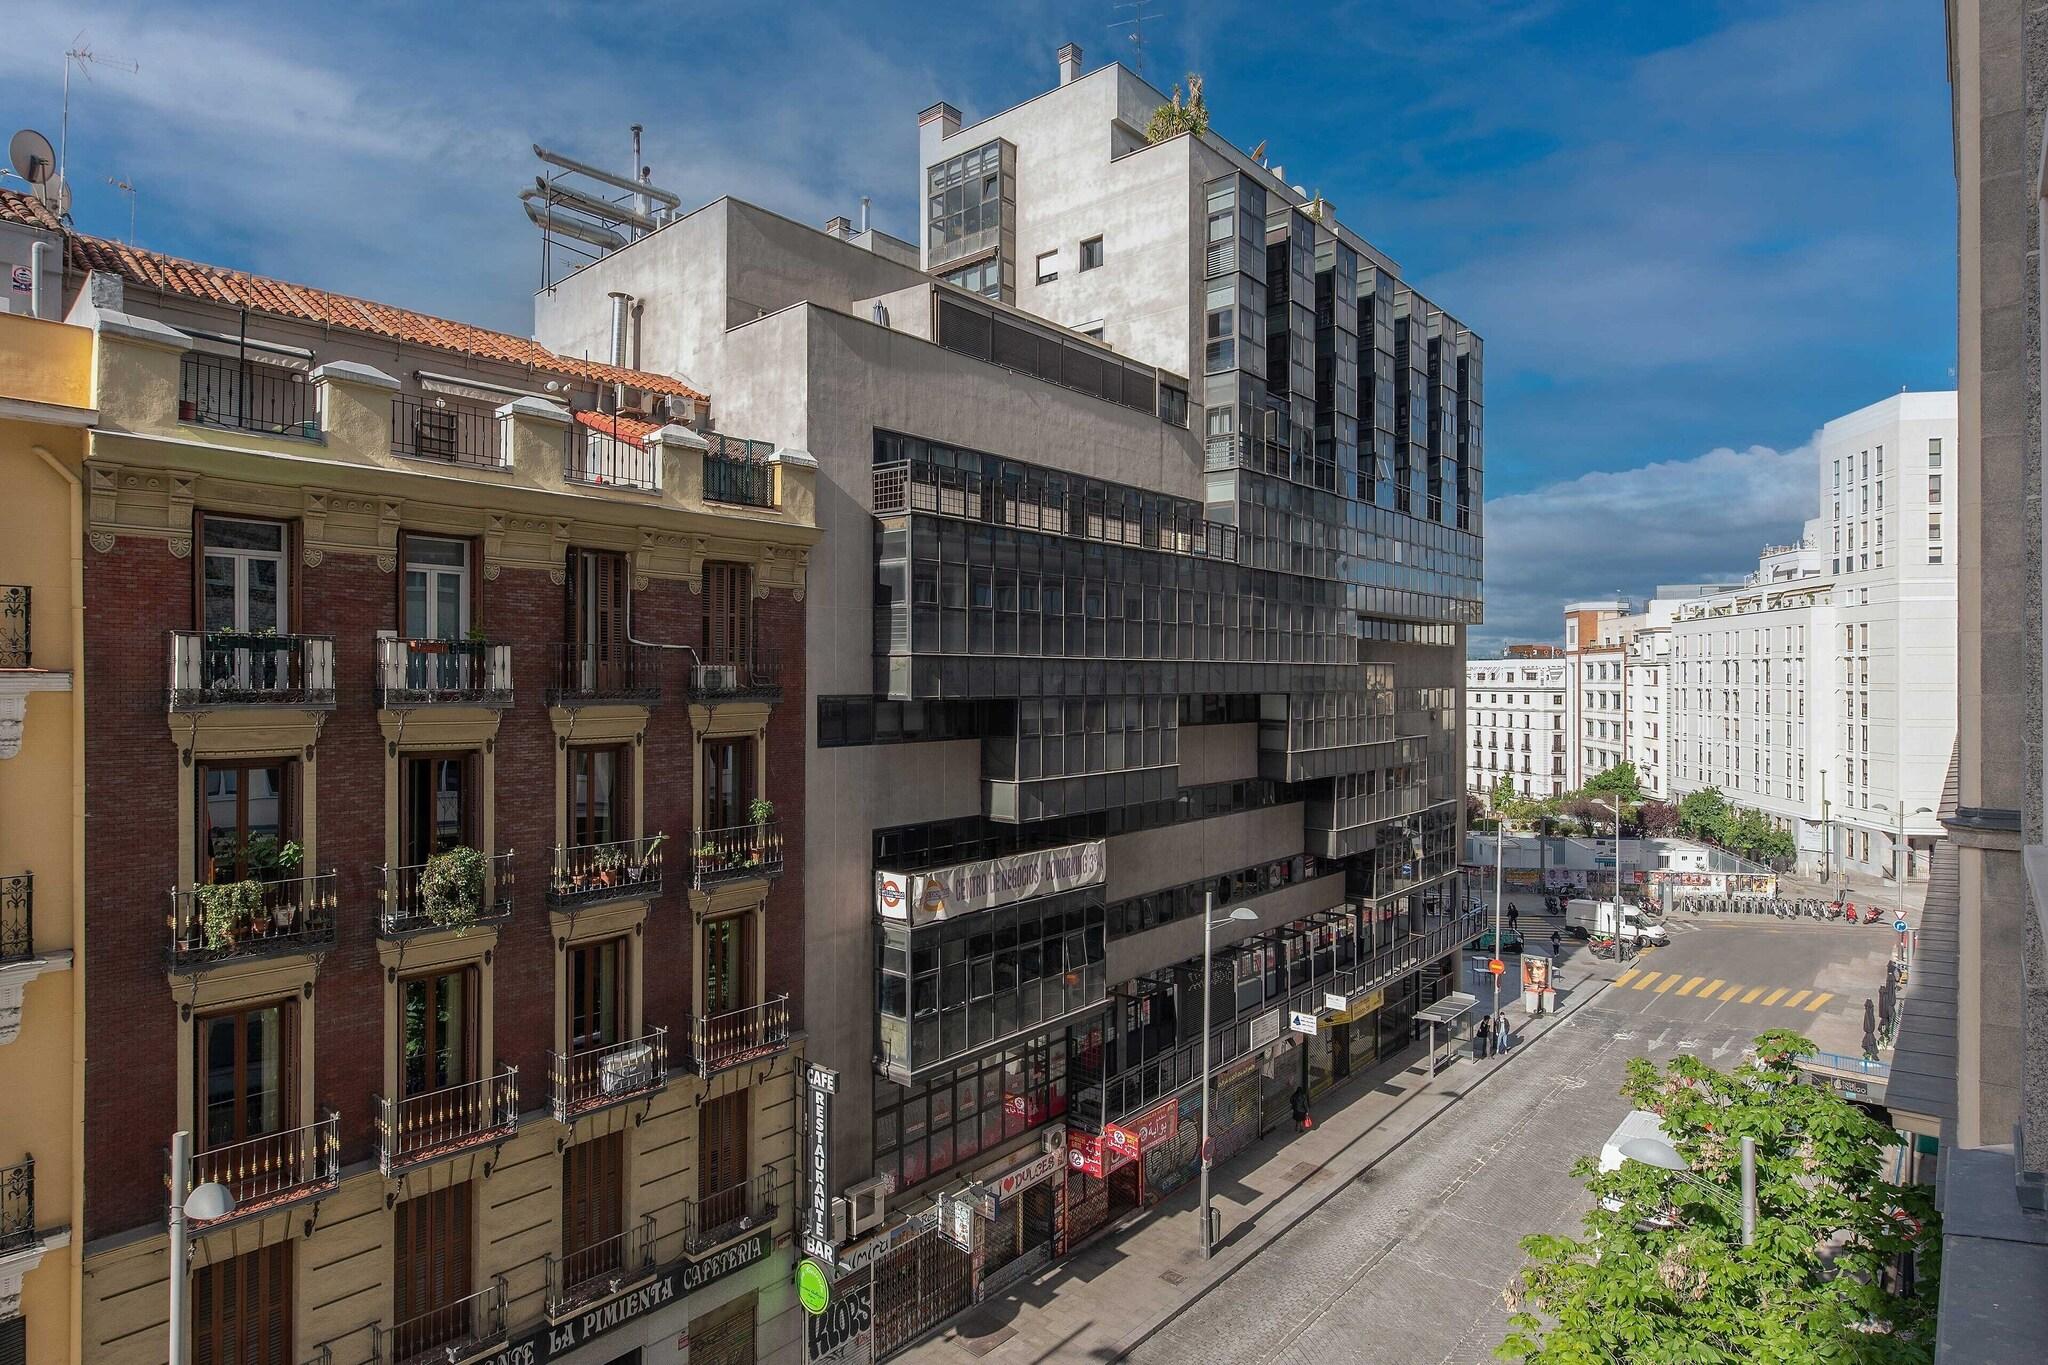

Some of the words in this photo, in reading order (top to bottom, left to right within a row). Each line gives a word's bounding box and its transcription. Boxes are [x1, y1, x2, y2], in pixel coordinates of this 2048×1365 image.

[955, 873, 987, 901] CENTRO
[990, 872, 1001, 893] DE
[1001, 863, 1039, 891] NEGOCIOS
[1045, 855, 1088, 881] COWORKING
[807, 1068, 834, 1091] CAFE
[814, 1091, 825, 1238] RESTAURANTE
[1015, 1155, 1055, 1189] DULCES
[807, 1237, 833, 1263] BAR
[549, 1323, 574, 1355] LA
[582, 1275, 675, 1339] PIMIENTA
[683, 1237, 762, 1290] CAFETERIA
